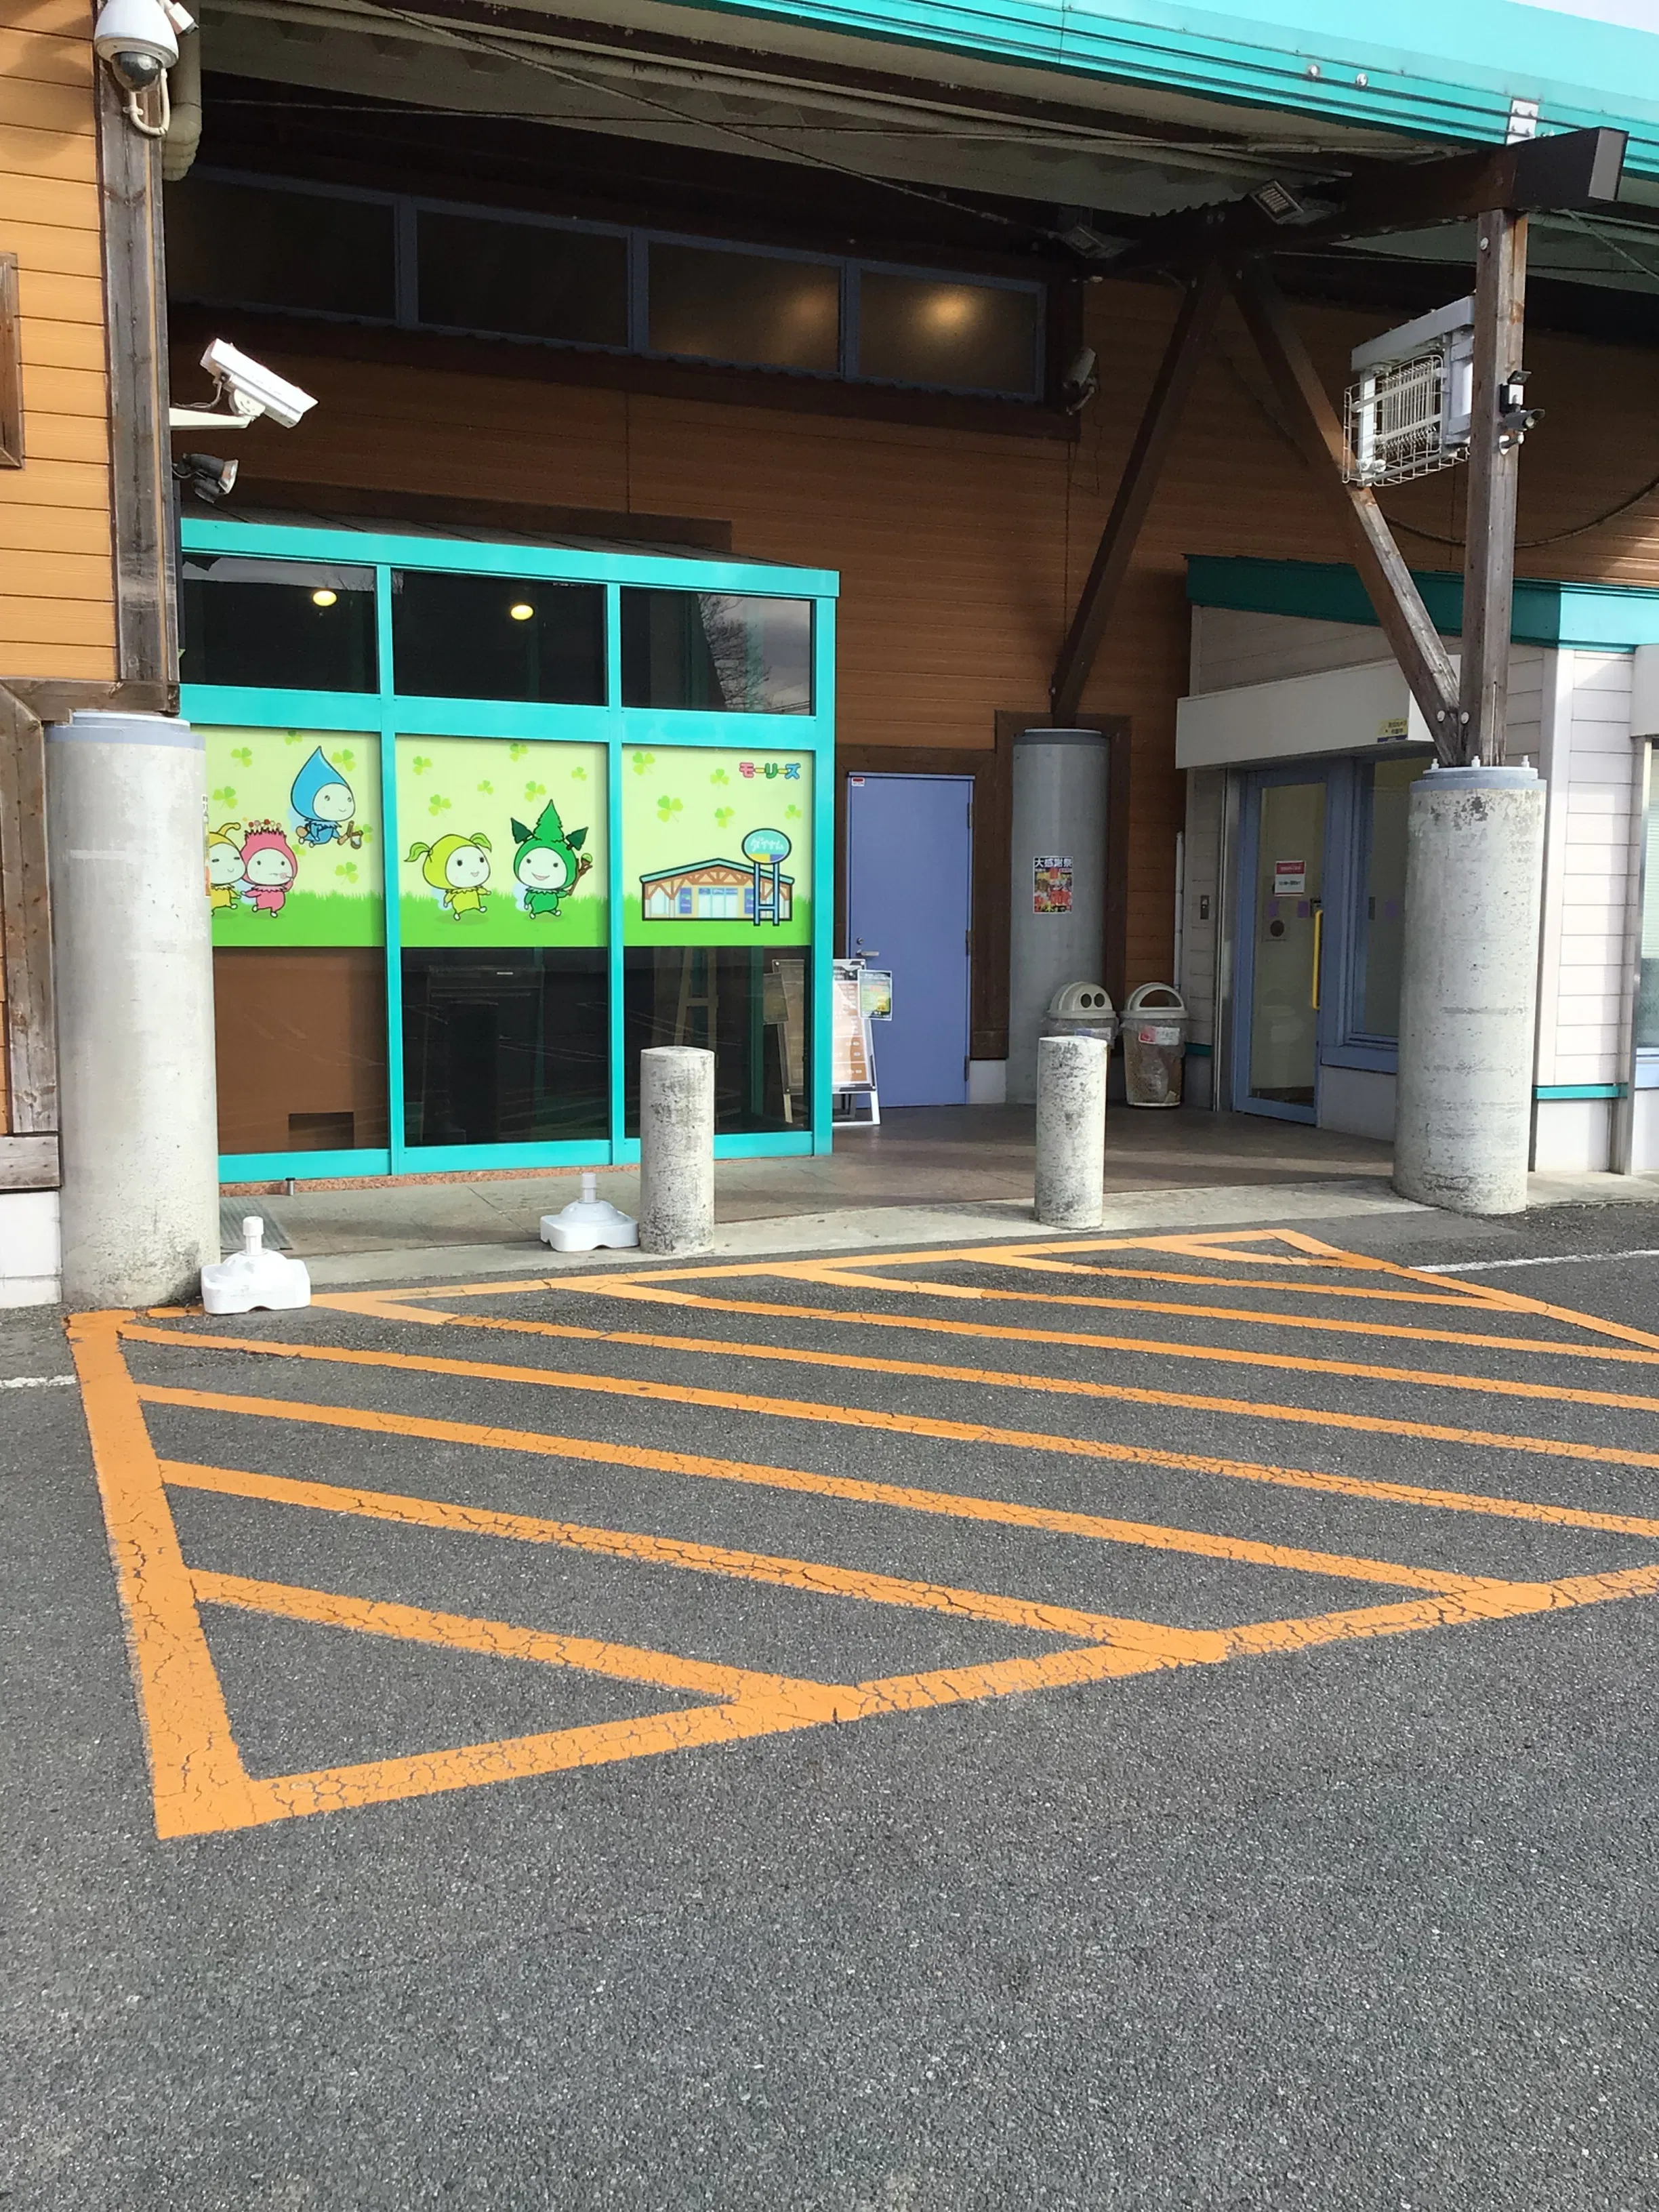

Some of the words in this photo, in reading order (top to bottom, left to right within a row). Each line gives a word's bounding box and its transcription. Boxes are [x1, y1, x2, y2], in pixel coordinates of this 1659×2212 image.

[739, 762, 801, 779] モーリーズ
